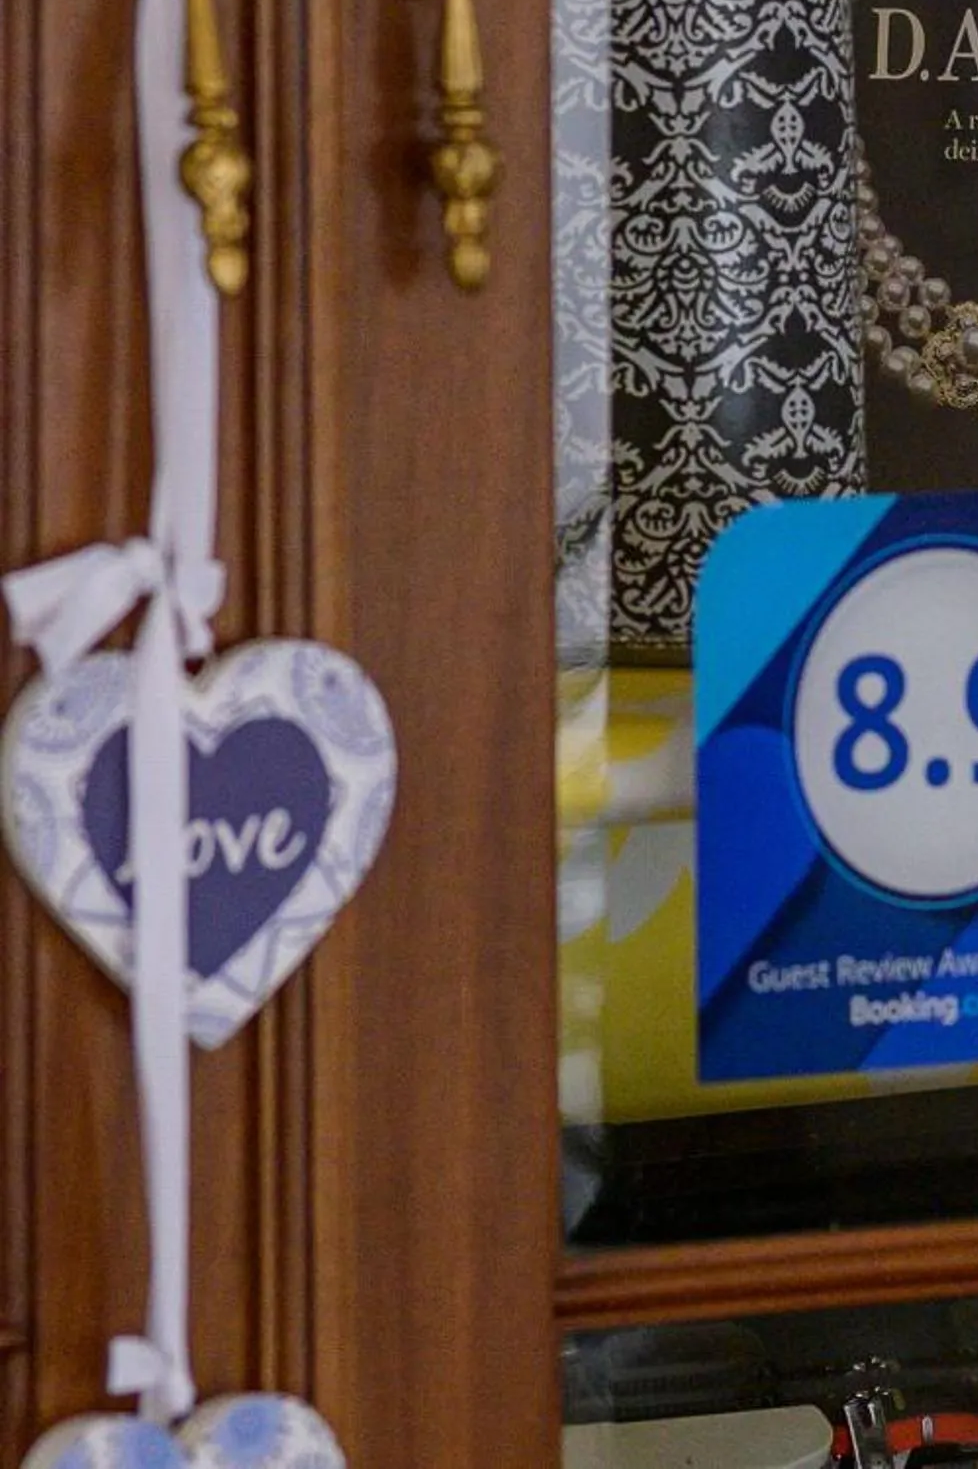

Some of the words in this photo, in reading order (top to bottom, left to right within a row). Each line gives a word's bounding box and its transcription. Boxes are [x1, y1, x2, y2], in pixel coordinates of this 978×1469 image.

[944, 109, 963, 130] A
[747, 958, 830, 994] Guest
[836, 952, 933, 987] Review
